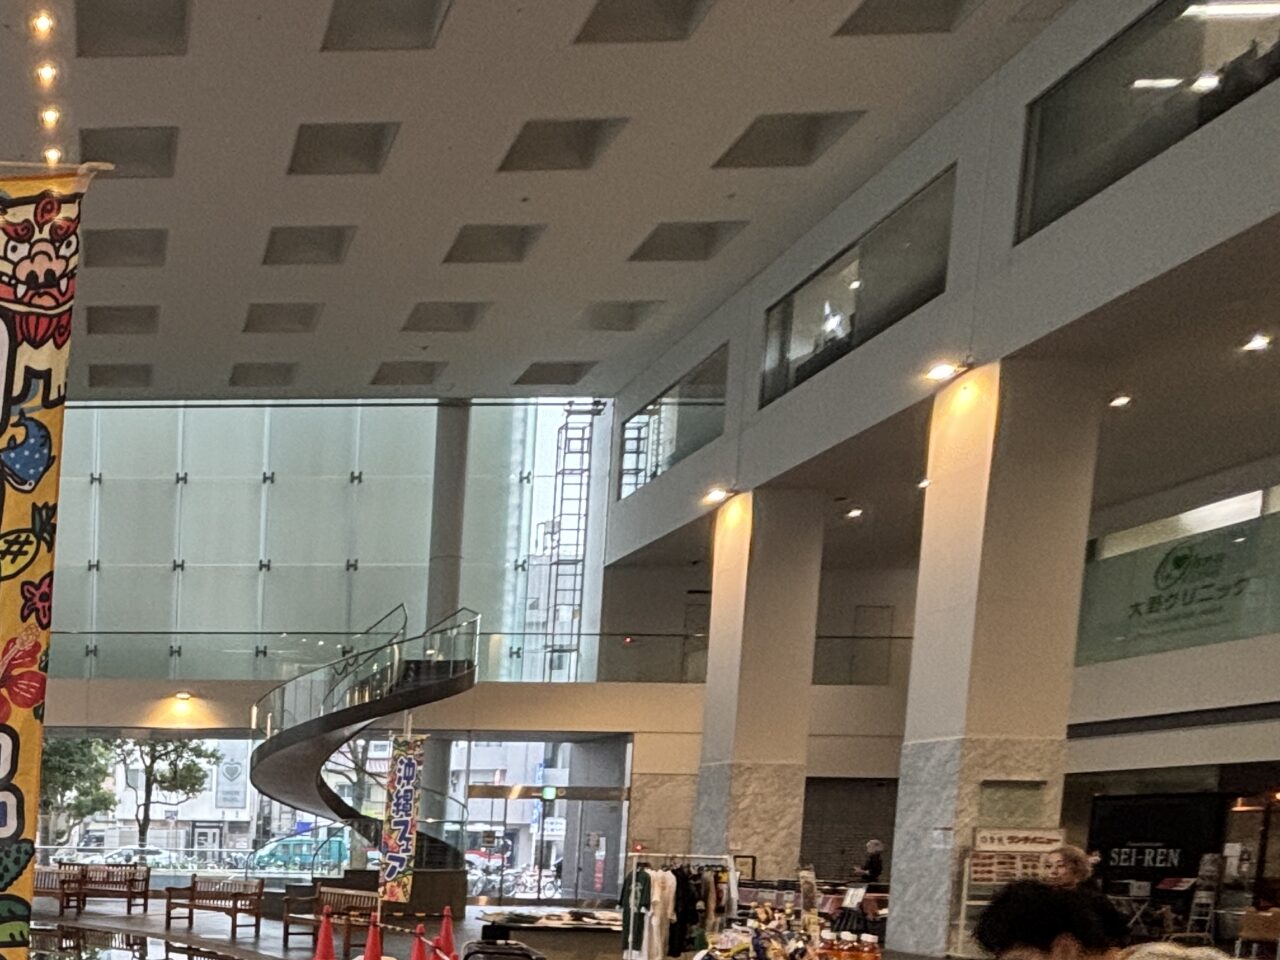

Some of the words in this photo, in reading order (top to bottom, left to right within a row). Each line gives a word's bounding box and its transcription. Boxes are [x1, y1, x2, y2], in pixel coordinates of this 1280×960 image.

[384, 757, 417, 880] 沖縄フェア
[1110, 848, 1182, 867] SEI-REN
